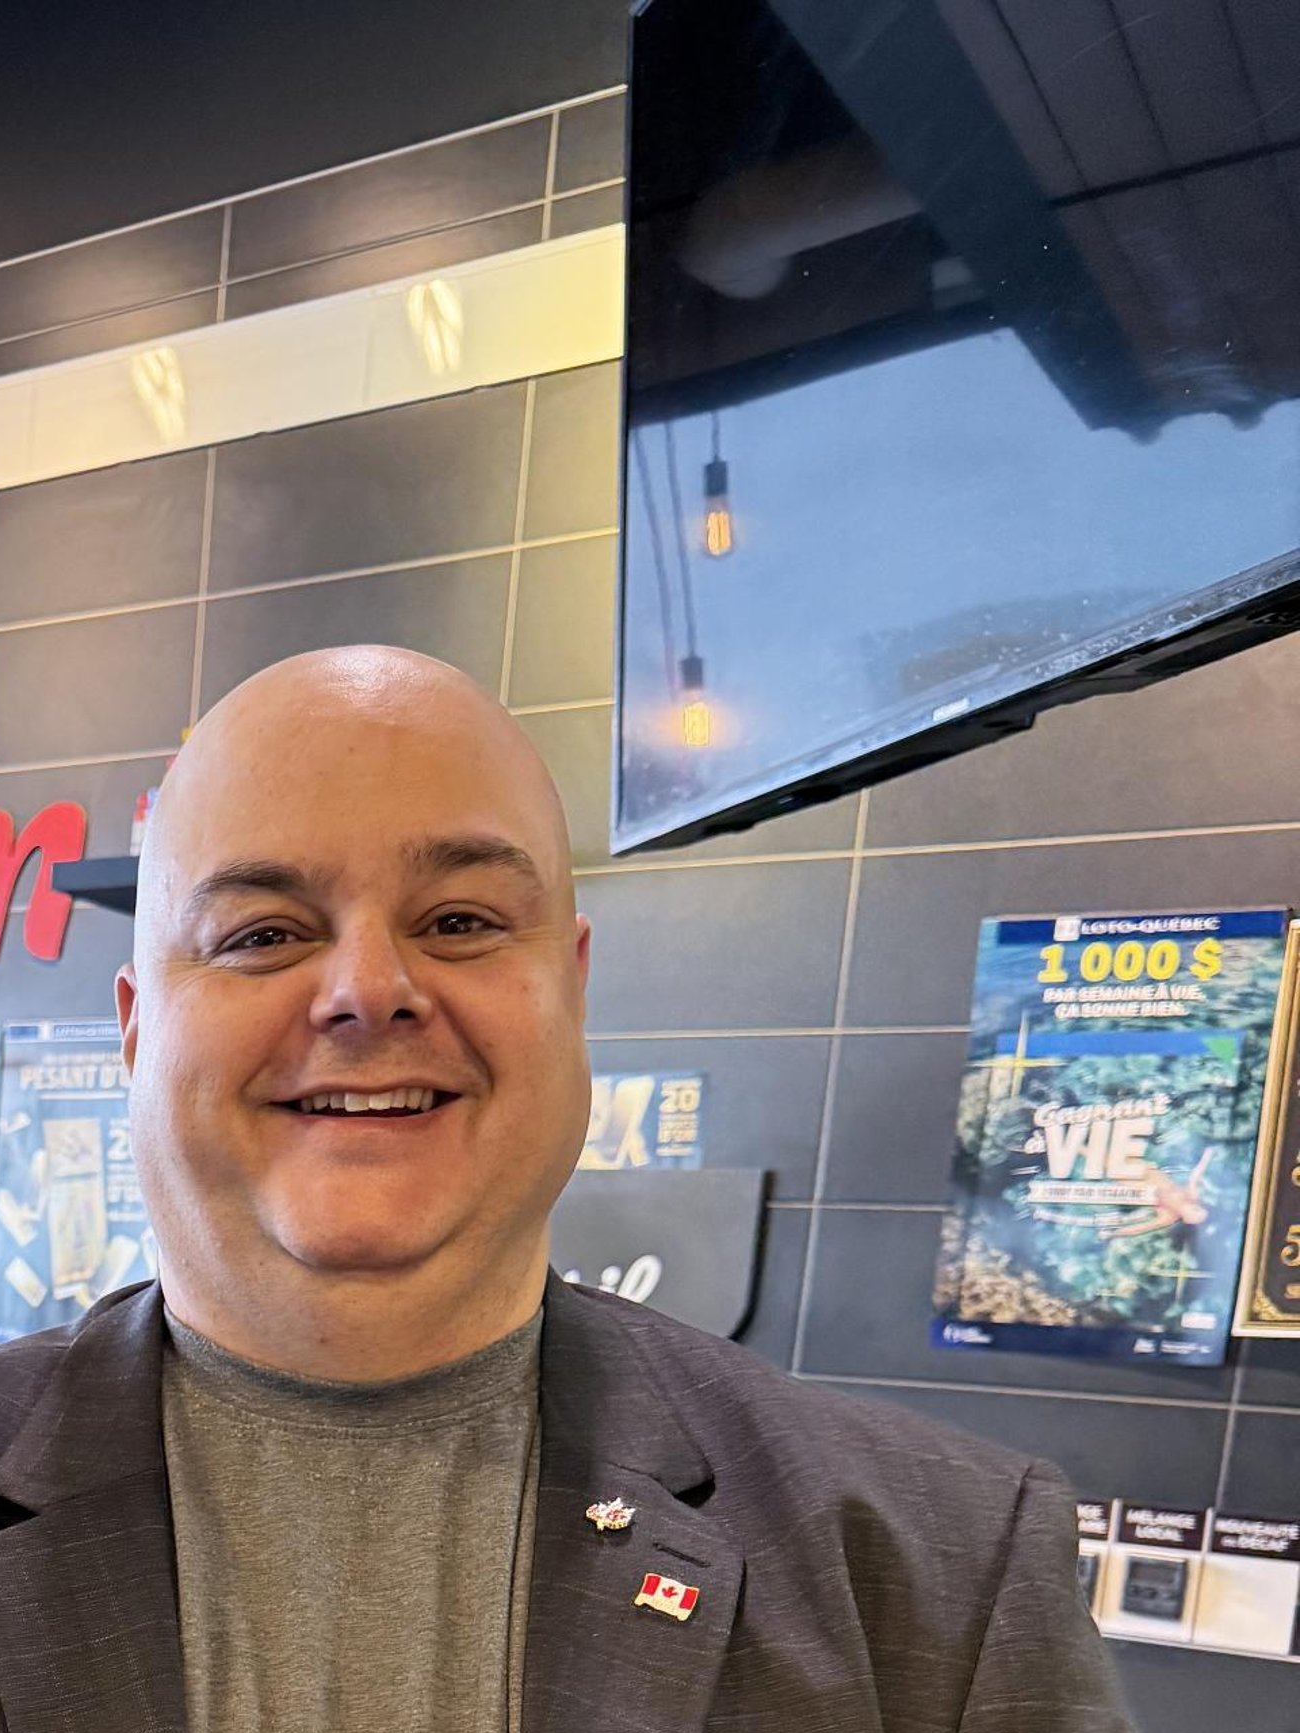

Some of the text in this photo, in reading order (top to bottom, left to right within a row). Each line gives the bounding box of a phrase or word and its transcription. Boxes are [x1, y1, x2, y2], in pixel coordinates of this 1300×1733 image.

[1037, 936, 1224, 983] 1 000 $
[1045, 1118, 1156, 1180] VIE
